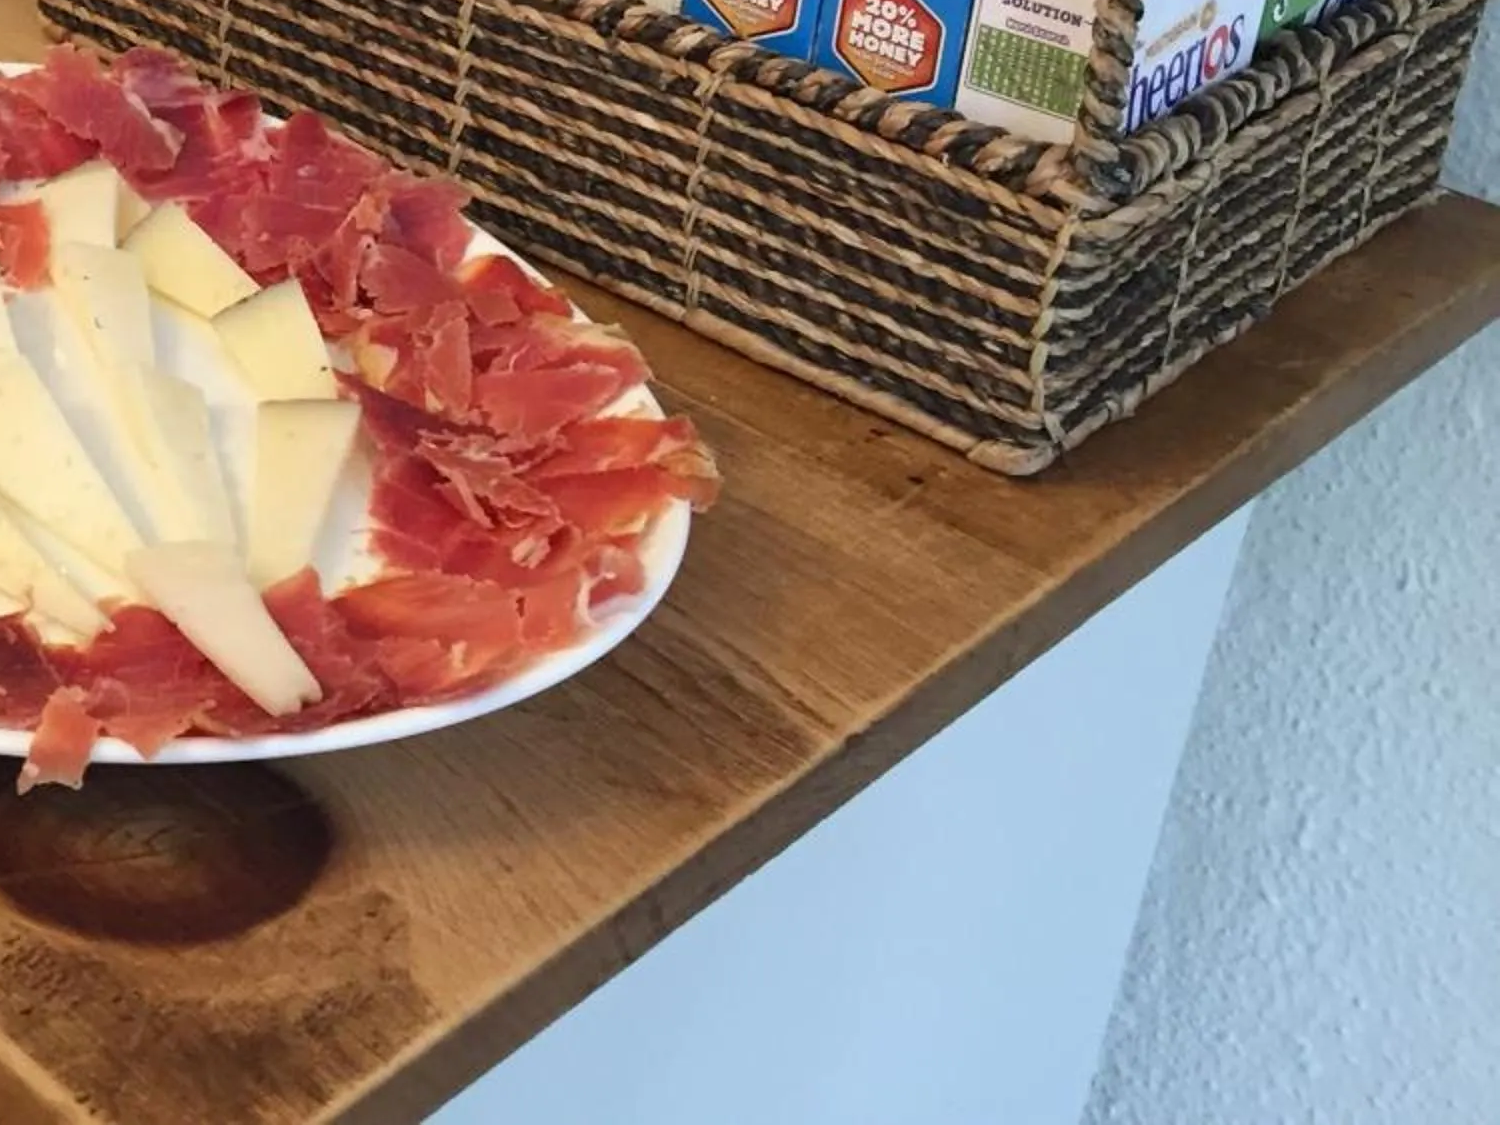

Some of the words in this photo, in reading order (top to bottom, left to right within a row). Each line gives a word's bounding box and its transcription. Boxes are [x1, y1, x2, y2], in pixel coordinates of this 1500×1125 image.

[849, 30, 924, 68] HONEY
[851, 10, 926, 52] MORE
[1125, 14, 1245, 139] heerios
